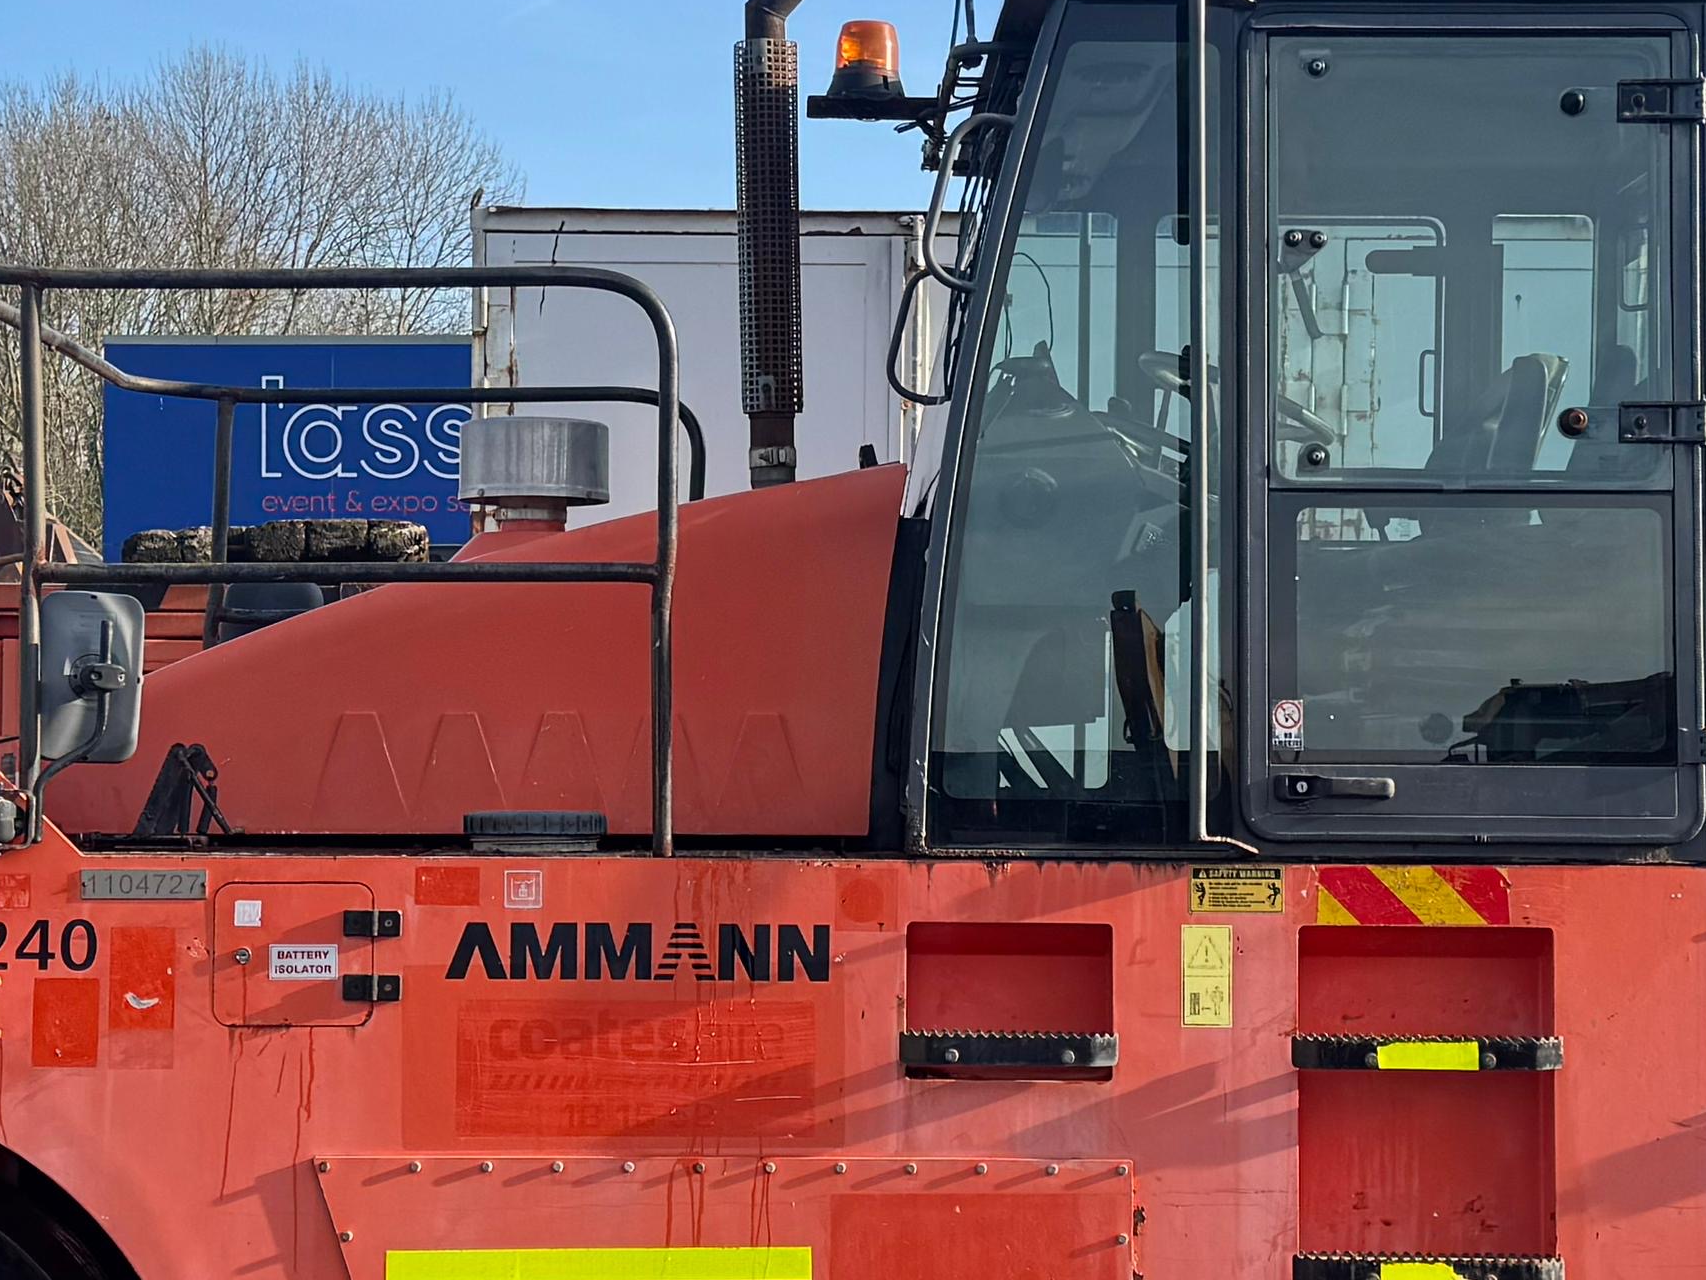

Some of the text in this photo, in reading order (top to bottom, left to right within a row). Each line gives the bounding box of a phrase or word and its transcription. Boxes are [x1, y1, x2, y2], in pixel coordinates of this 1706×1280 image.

[261, 491, 336, 512] event
[345, 490, 363, 512] &
[371, 495, 438, 517] expo
[84, 872, 200, 896] 1104727
[277, 950, 330, 960] BATTERY
[444, 921, 831, 982] AMMANN
[274, 965, 332, 974] ISOLATOR
